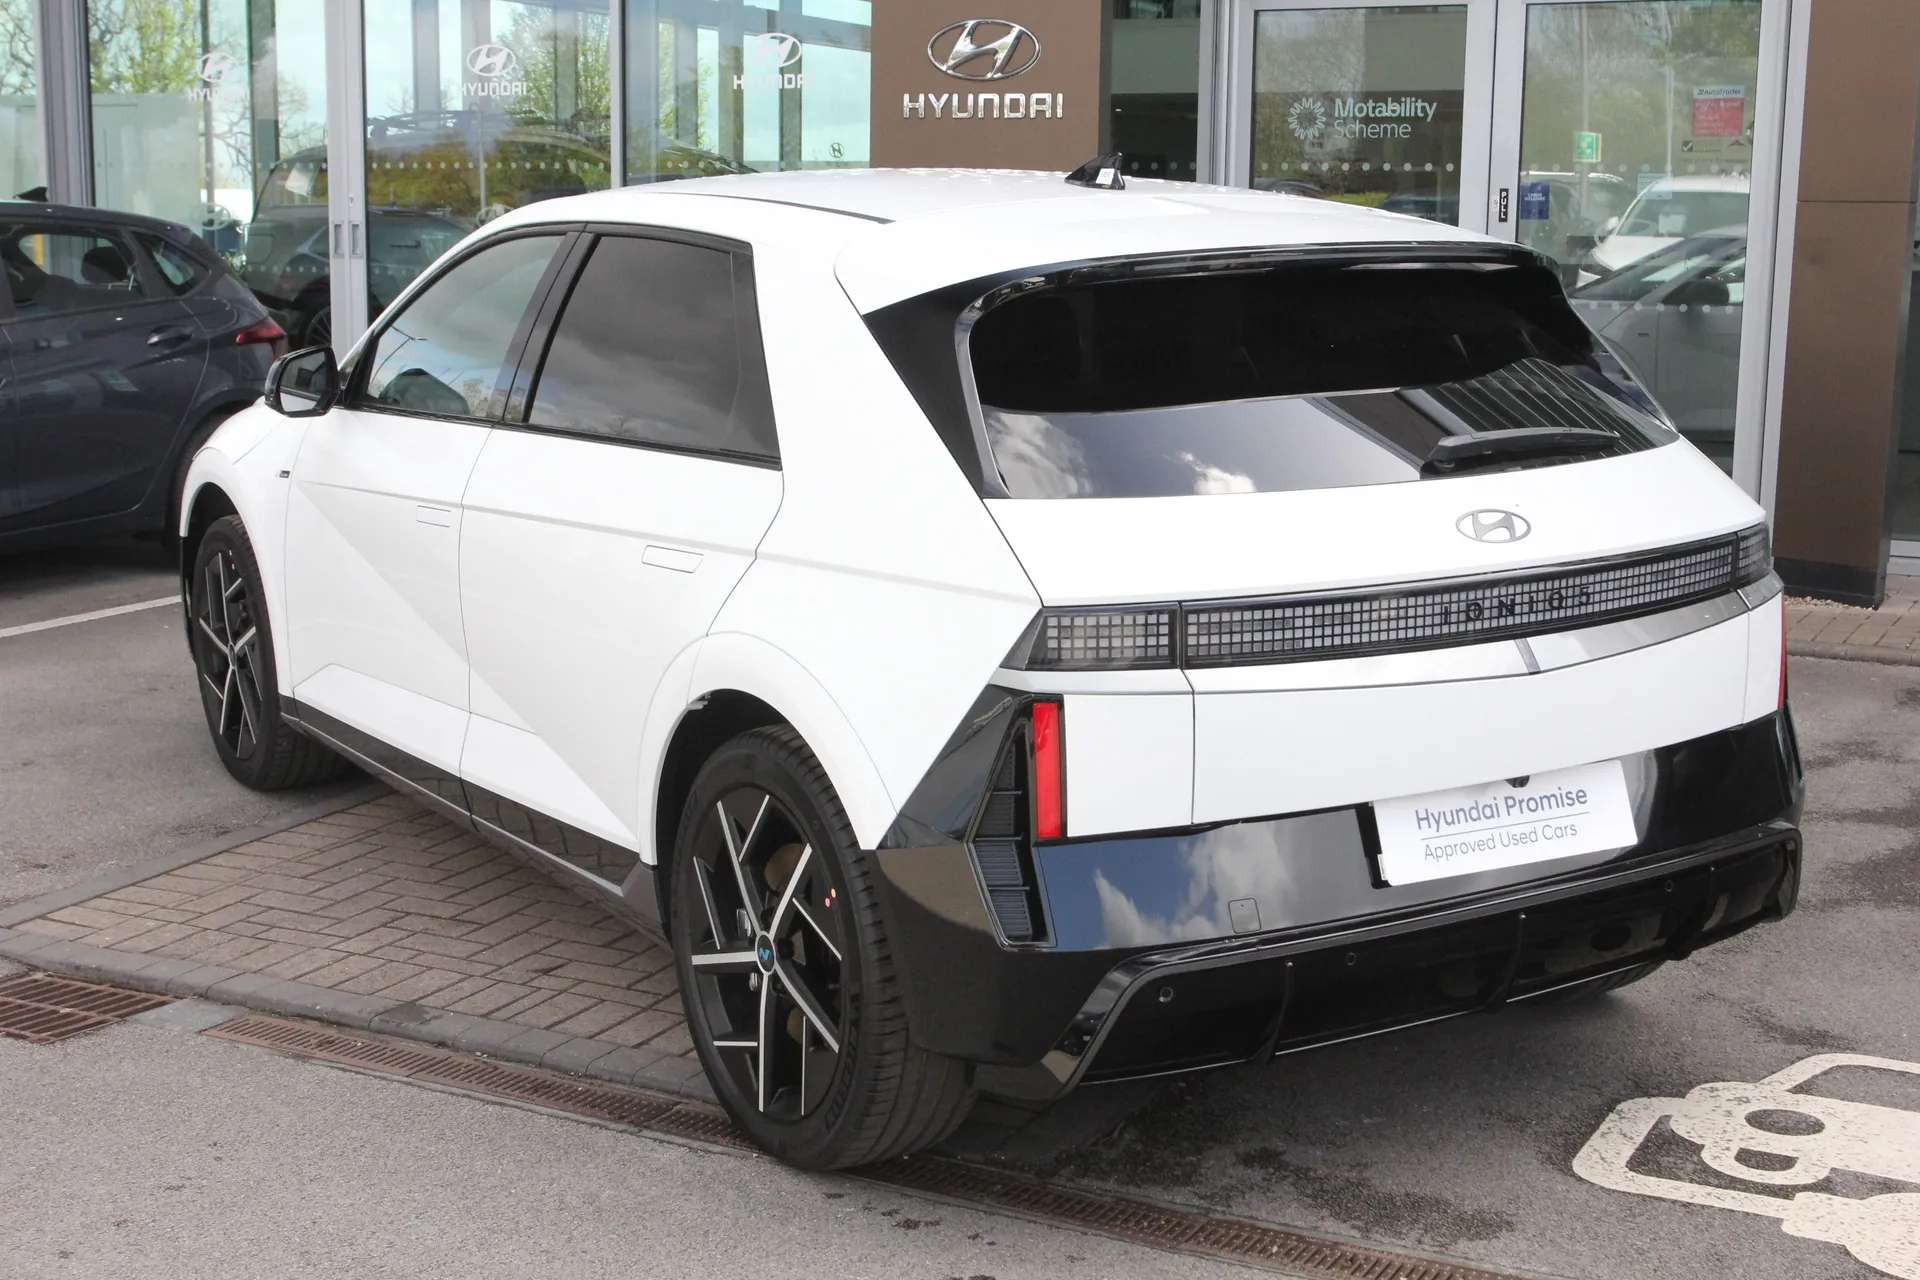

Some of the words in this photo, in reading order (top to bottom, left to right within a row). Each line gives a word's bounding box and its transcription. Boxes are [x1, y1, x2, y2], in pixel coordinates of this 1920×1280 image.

[461, 81, 528, 97] HYUNDAI
[733, 73, 811, 90] HNDA
[903, 93, 1064, 119] HYUNDAI
[1334, 97, 1438, 122] Motability
[1334, 119, 1412, 139] Scheme
[1500, 191, 1508, 219] PULL
[1443, 589, 1566, 625] IONIQ
[1579, 586, 1591, 606] 5
[1415, 796, 1501, 833] Hyundai
[1504, 786, 1588, 817] Promise
[1424, 833, 1497, 862] Approved
[1499, 827, 1539, 848] Used
[1541, 823, 1578, 841] Cars
